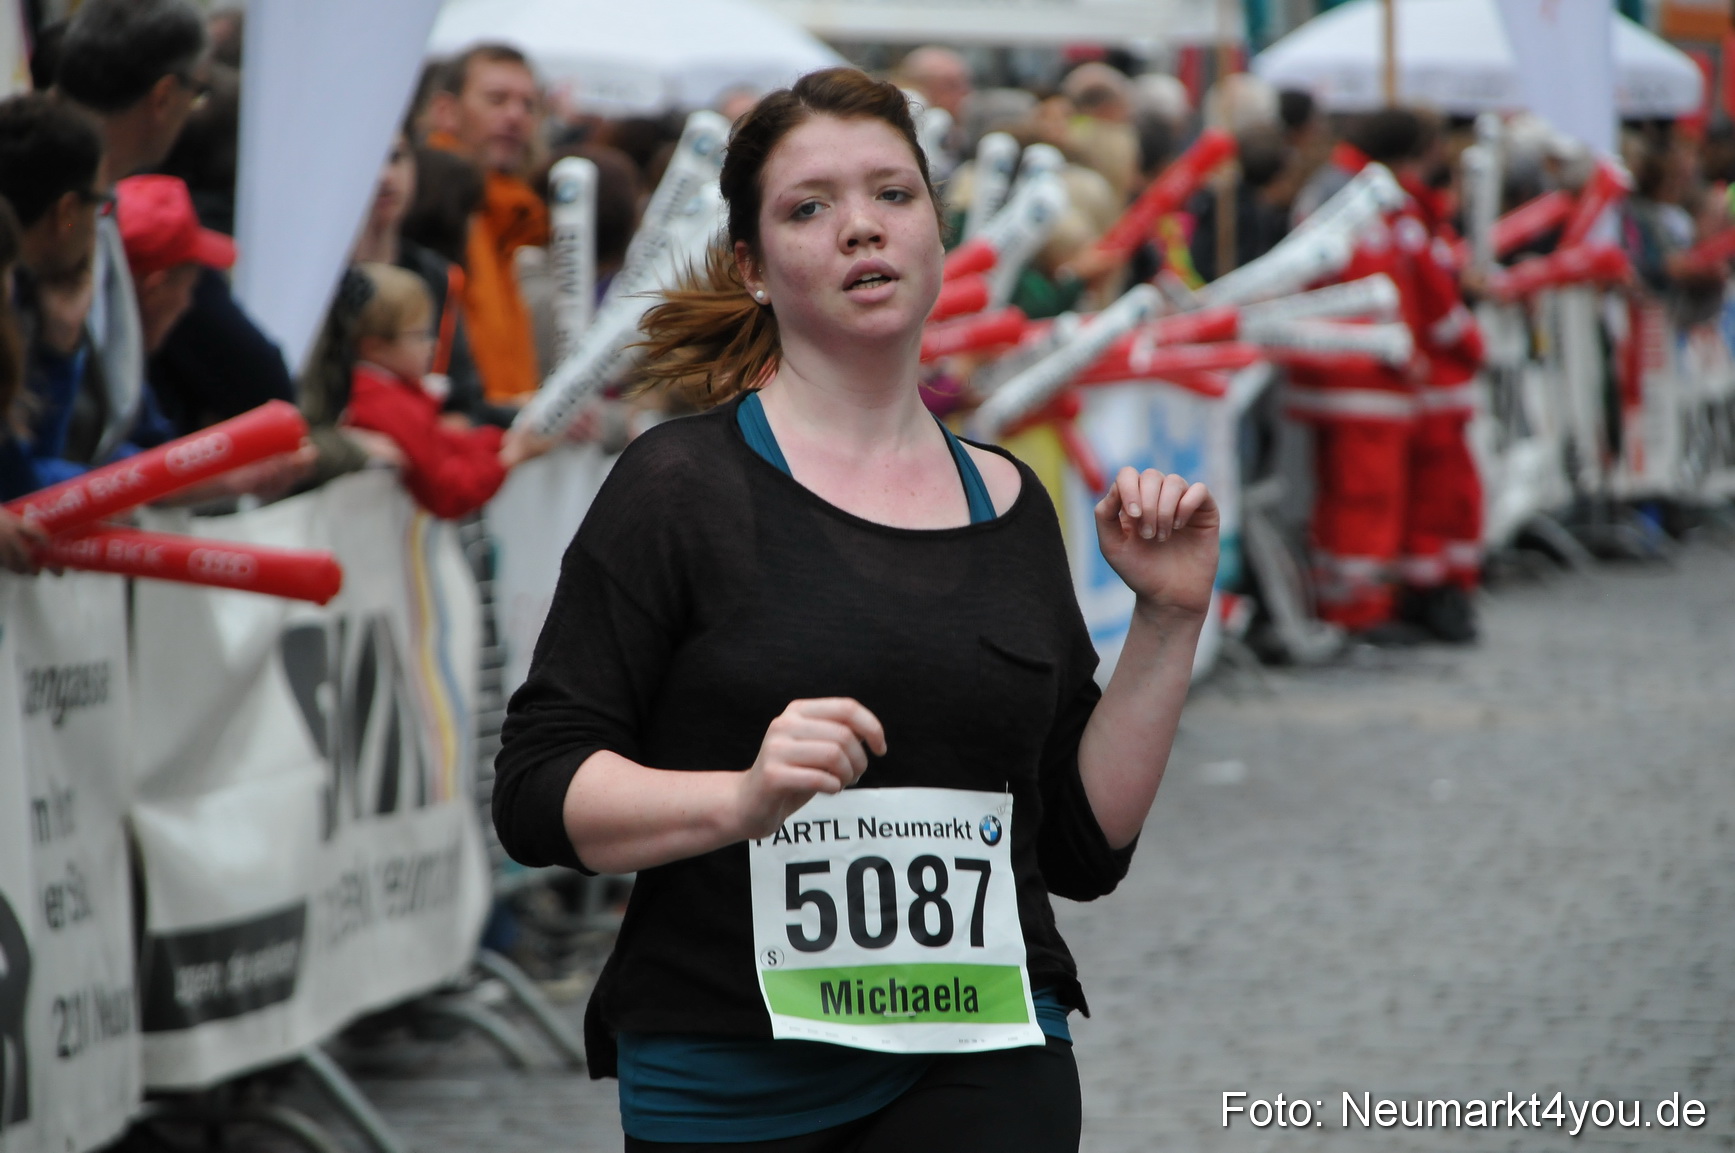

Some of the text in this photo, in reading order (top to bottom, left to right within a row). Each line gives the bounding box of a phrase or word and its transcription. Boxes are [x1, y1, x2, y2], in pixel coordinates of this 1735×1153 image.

[857, 816, 974, 841] Neumarkt
[785, 854, 992, 953] 5087
[767, 950, 778, 967] S
[819, 976, 979, 1017] Michaela
